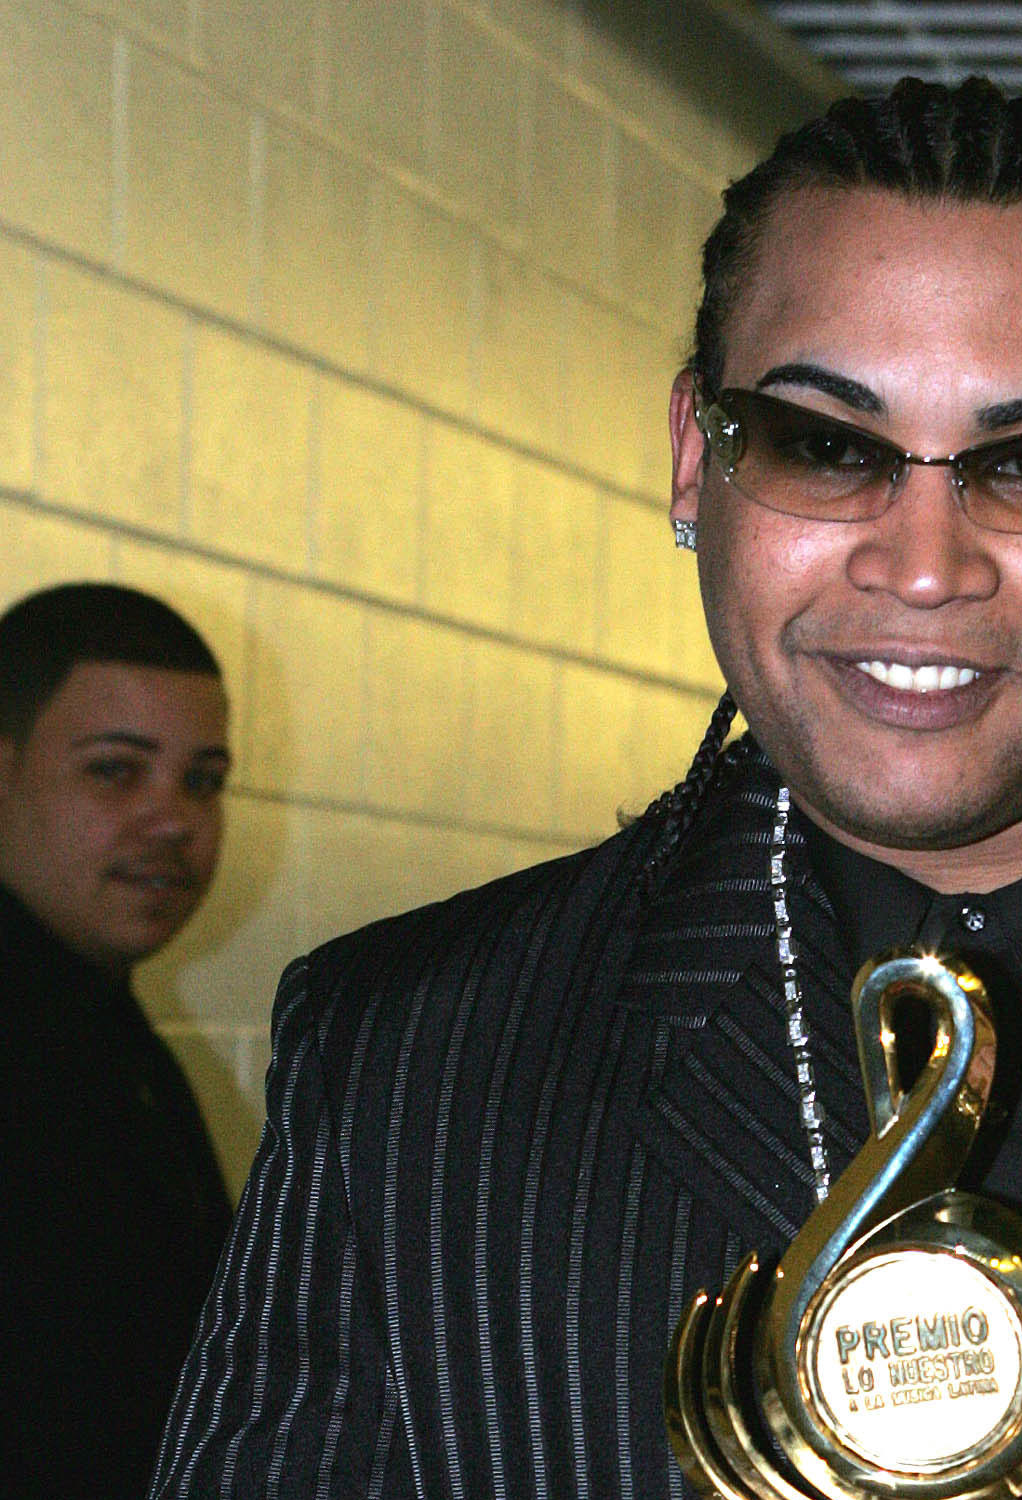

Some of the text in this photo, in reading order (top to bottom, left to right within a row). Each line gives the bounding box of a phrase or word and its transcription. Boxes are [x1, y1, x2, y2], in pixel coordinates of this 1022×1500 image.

[835, 1306, 989, 1365] PREMIO
[842, 1347, 995, 1395] LO NUESTRO
